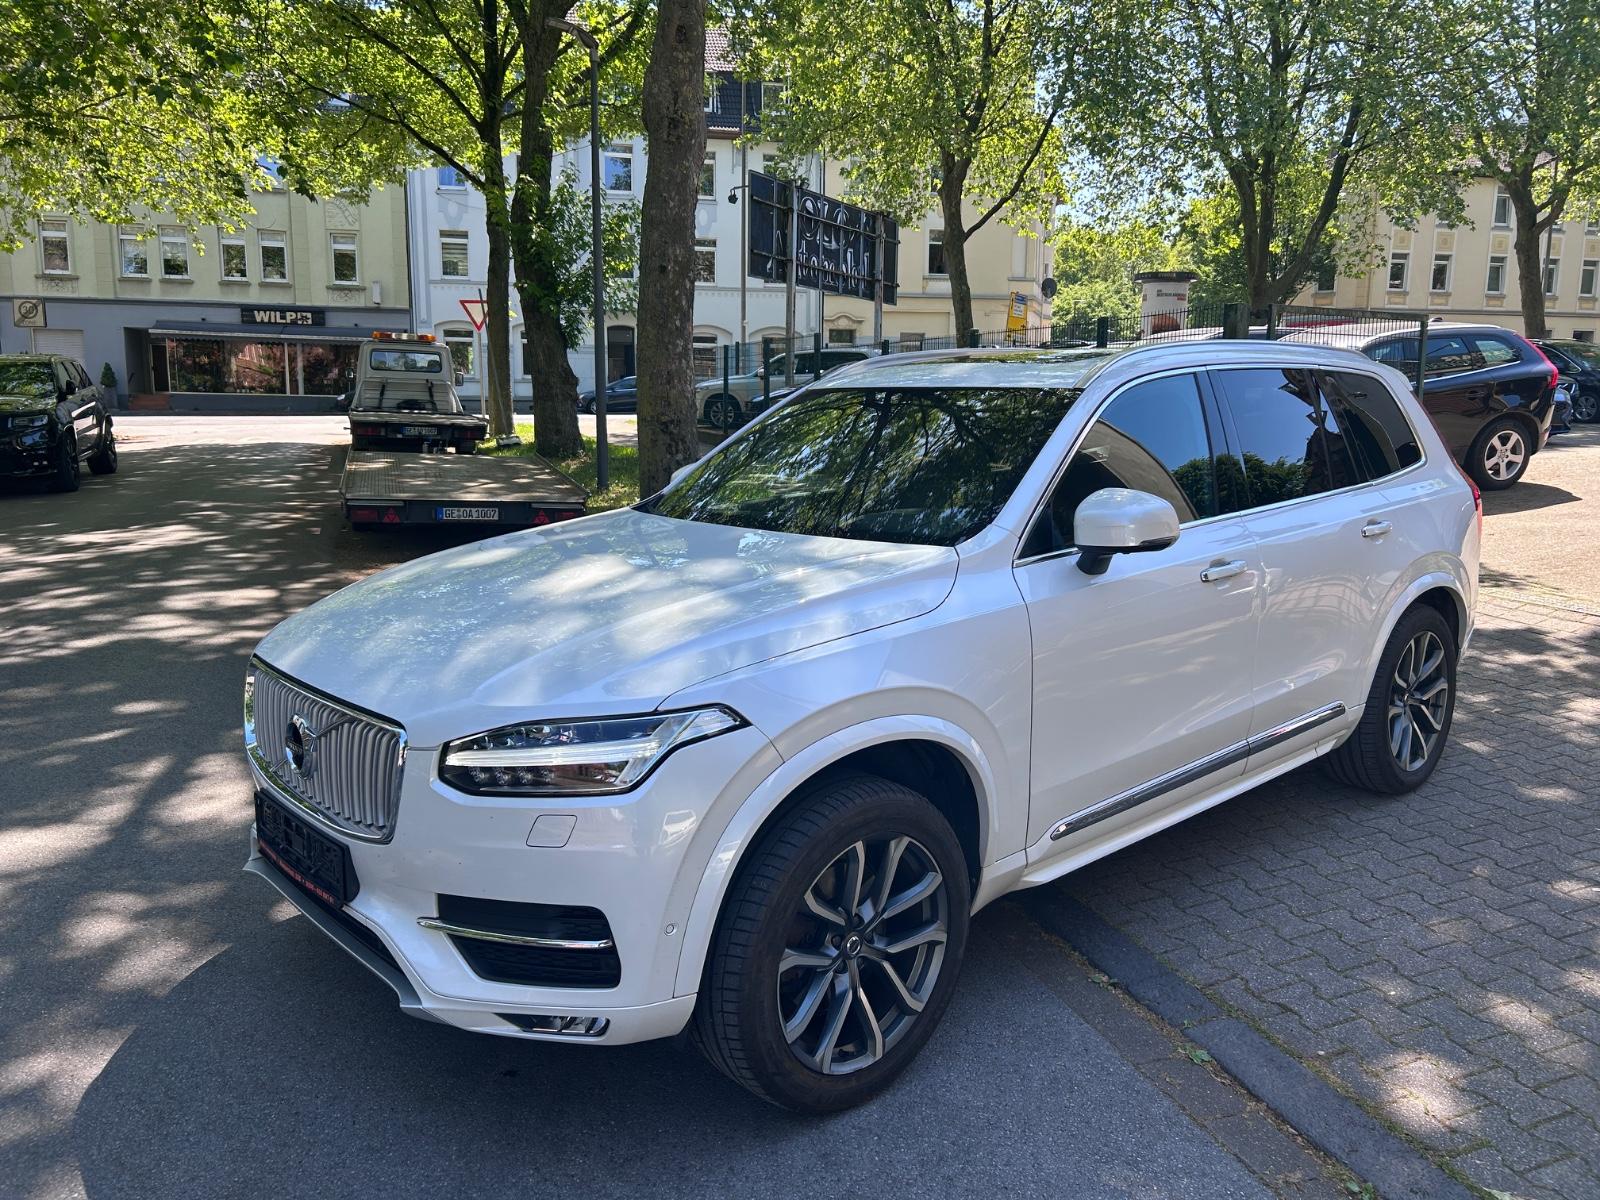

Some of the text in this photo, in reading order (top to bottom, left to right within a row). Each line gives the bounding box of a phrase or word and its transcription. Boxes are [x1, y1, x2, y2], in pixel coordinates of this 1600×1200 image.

[22, 305, 35, 315] 30
[445, 508, 497, 519] GE OA 1007
